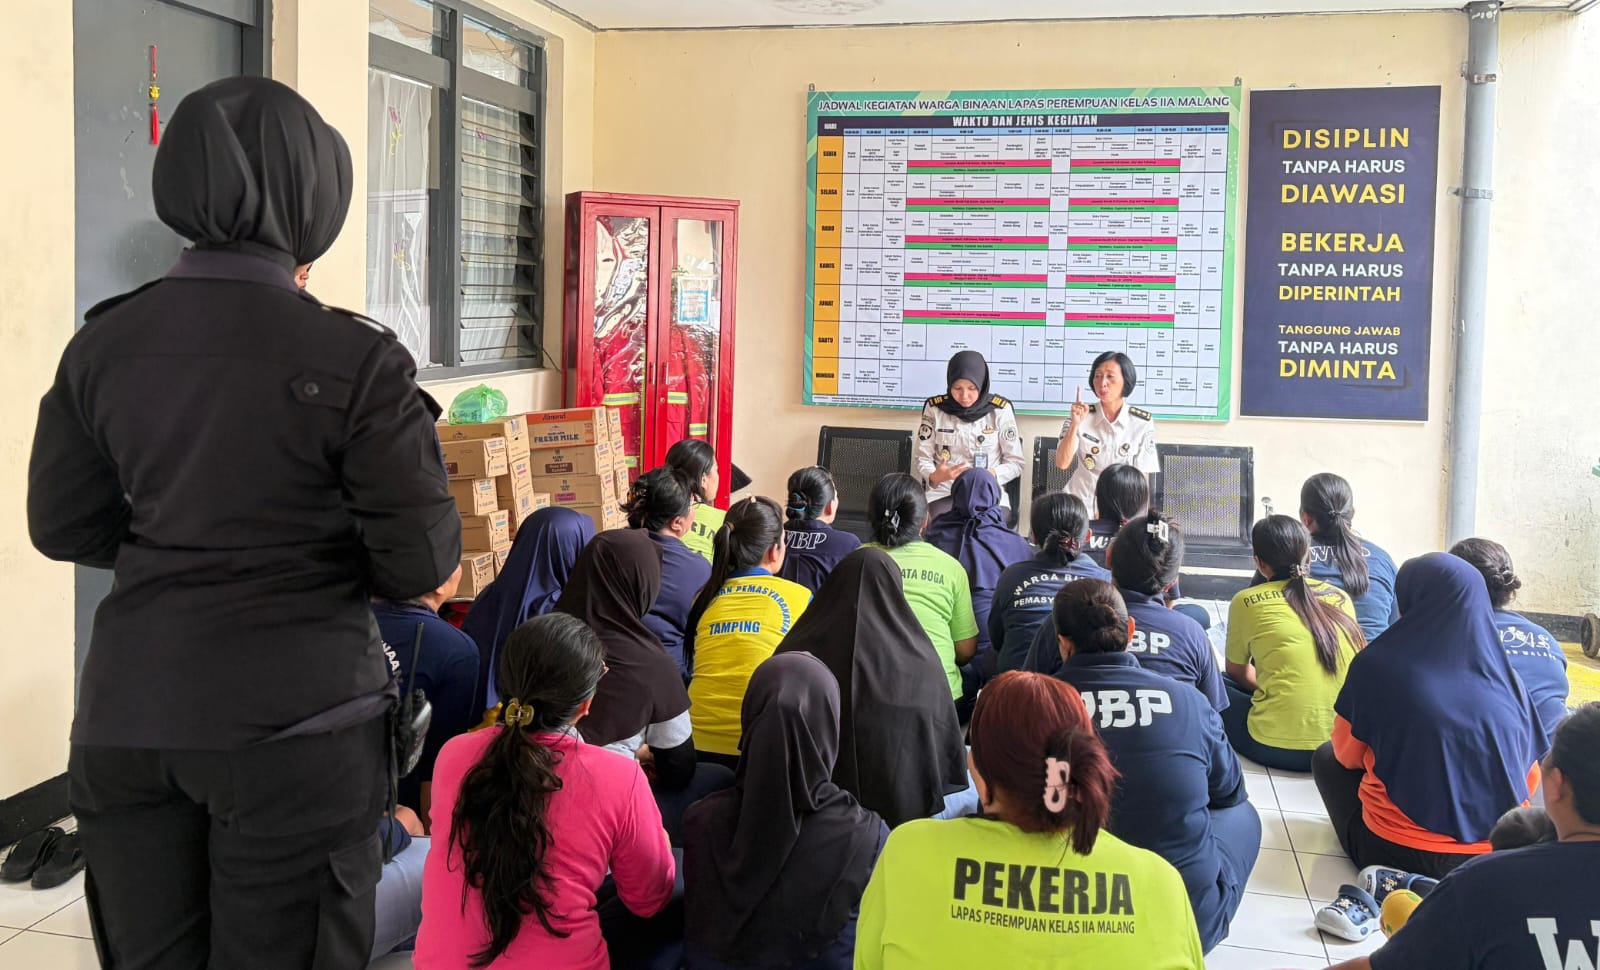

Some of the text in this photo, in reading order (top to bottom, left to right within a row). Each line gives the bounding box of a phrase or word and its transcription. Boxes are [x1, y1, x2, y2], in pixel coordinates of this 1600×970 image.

[818, 97, 1230, 111] JADWAL KEGIATAN WARGA BINAAN LAPAS PEREMPUAN KELAS IIA MALANG
[952, 115, 1098, 127] WAKTU DAN JENIS KEGIATAN
[1282, 127, 1410, 149] DISIPLIN
[1282, 159, 1405, 174] TANPA HARUS
[1281, 183, 1405, 204] DIAWASI
[1281, 232, 1405, 253] BEKERJA
[1278, 263, 1404, 278] TANPA HARUS
[1279, 285, 1401, 302] DIPERINTAH
[1278, 325, 1401, 336] TANGGUNG JAWAB
[1278, 341, 1399, 356] TANPA HARUS
[1279, 359, 1396, 380] DIMINTA
[560, 433, 580, 441] MILK
[921, 569, 945, 586] BOGA
[1013, 573, 1058, 596] WARGA
[735, 584, 791, 634] PEMASYARAKATAN
[709, 621, 760, 635] TAMPING
[953, 857, 1135, 916] PEKERJA
[951, 905, 1135, 935] LAPAS PEREMPUAN KELAS IIA MALANG
